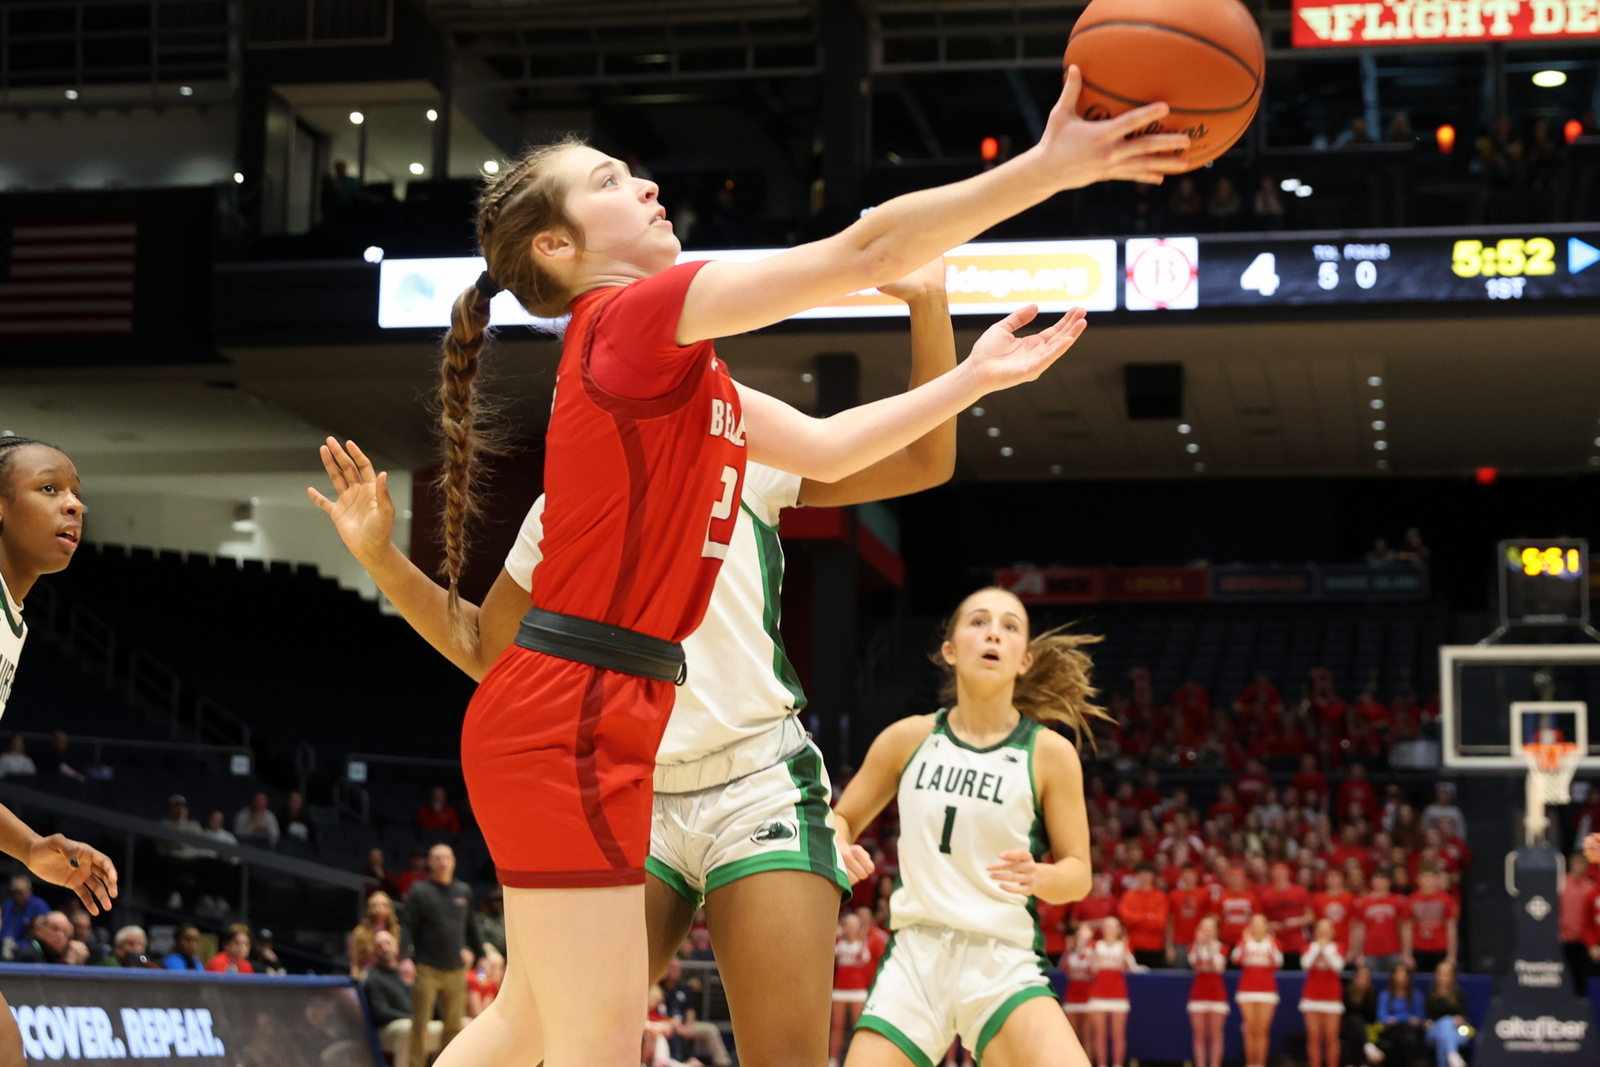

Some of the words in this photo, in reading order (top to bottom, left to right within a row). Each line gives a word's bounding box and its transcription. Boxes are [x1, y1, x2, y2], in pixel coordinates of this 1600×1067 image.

[1331, 0, 1519, 41] FLIGHT
[1530, 0, 1600, 34] DE
[1240, 252, 1280, 296] 4
[1355, 260, 1377, 289] 0
[1451, 237, 1556, 278] 5:52
[1485, 277, 1527, 299] 1ST
[701, 465, 738, 561] 2
[1521, 547, 1579, 576] 5:51
[915, 762, 1003, 805] LAUREL
[939, 805, 957, 855] 1
[10, 1005, 127, 1060] COVER.
[120, 1007, 225, 1057] REPEAT.
